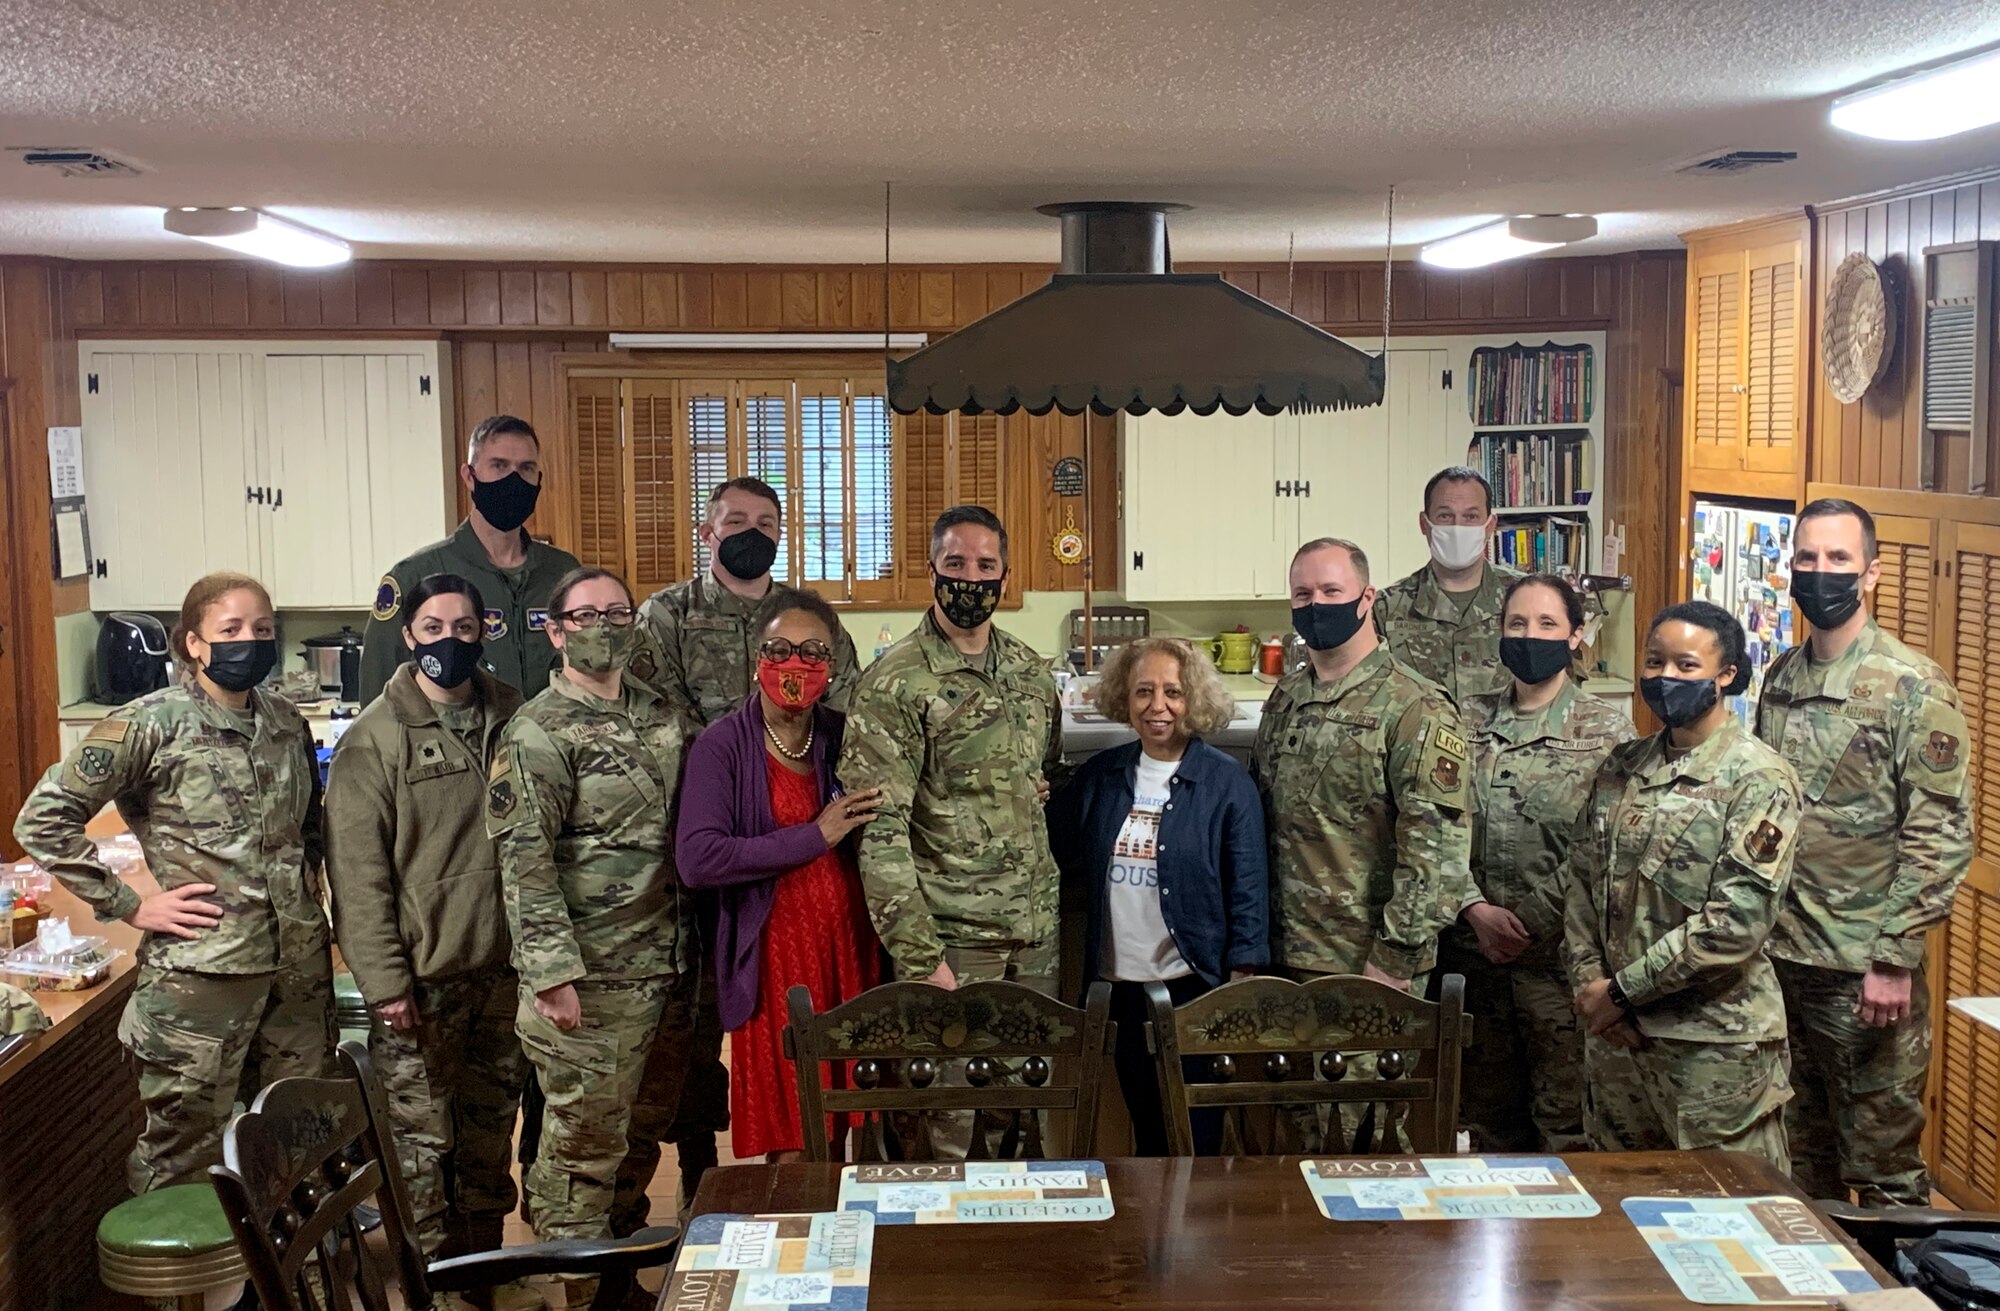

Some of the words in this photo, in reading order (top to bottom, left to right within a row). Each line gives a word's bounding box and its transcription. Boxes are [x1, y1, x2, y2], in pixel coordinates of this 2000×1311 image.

[1438, 731, 1463, 754] LRO
[1562, 741, 1575, 749] AIR
[1576, 740, 1600, 749] FORCE
[865, 1165, 959, 1177] LOVE
[1322, 1161, 1420, 1172] LOVE
[972, 1176, 1083, 1188] FAMILY
[1439, 1172, 1557, 1184] FAMILY
[963, 1203, 1110, 1218] TOGETHER
[1447, 1200, 1591, 1215] TOGETHER
[1772, 1205, 1828, 1244] LOVE
[735, 1223, 769, 1267] FAMILY
[828, 1212, 861, 1268] TOGETHER
[1666, 1242, 1733, 1300] TOGETHER
[1765, 1247, 1827, 1295] FAMILY
[674, 1272, 714, 1311] LOVE
